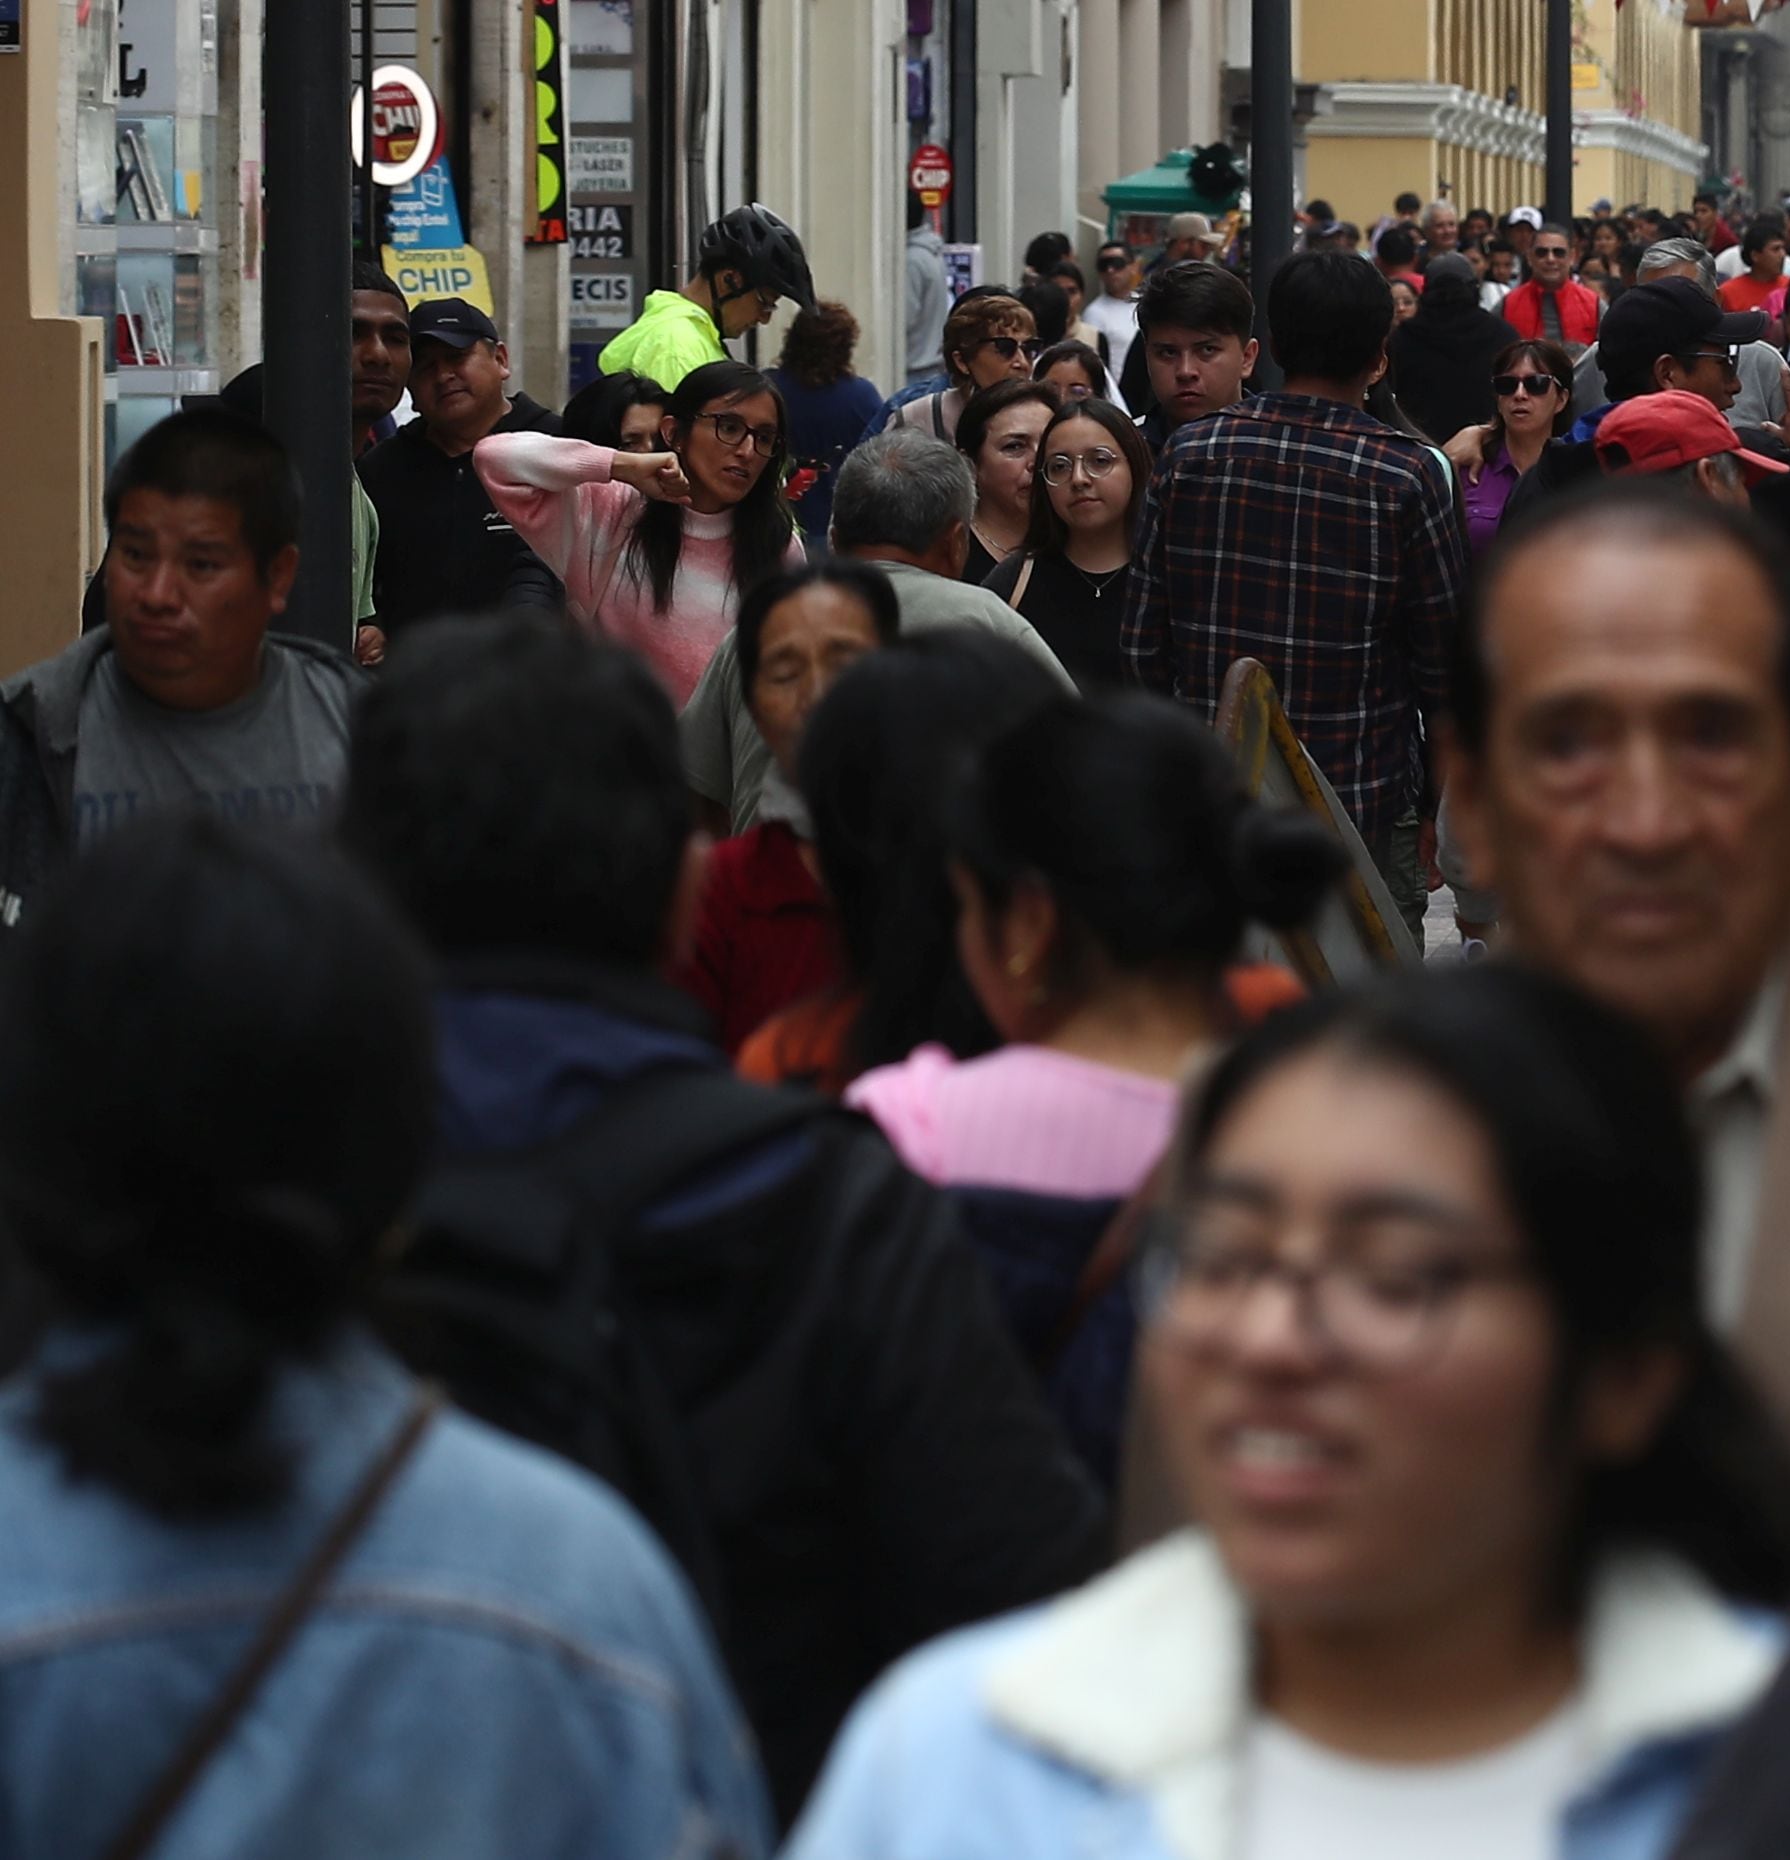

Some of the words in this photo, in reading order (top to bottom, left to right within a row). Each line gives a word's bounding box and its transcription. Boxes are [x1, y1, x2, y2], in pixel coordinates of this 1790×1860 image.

[395, 250, 447, 263] Compra
[397, 268, 472, 293] CHIP
[572, 279, 628, 300] ECIS
